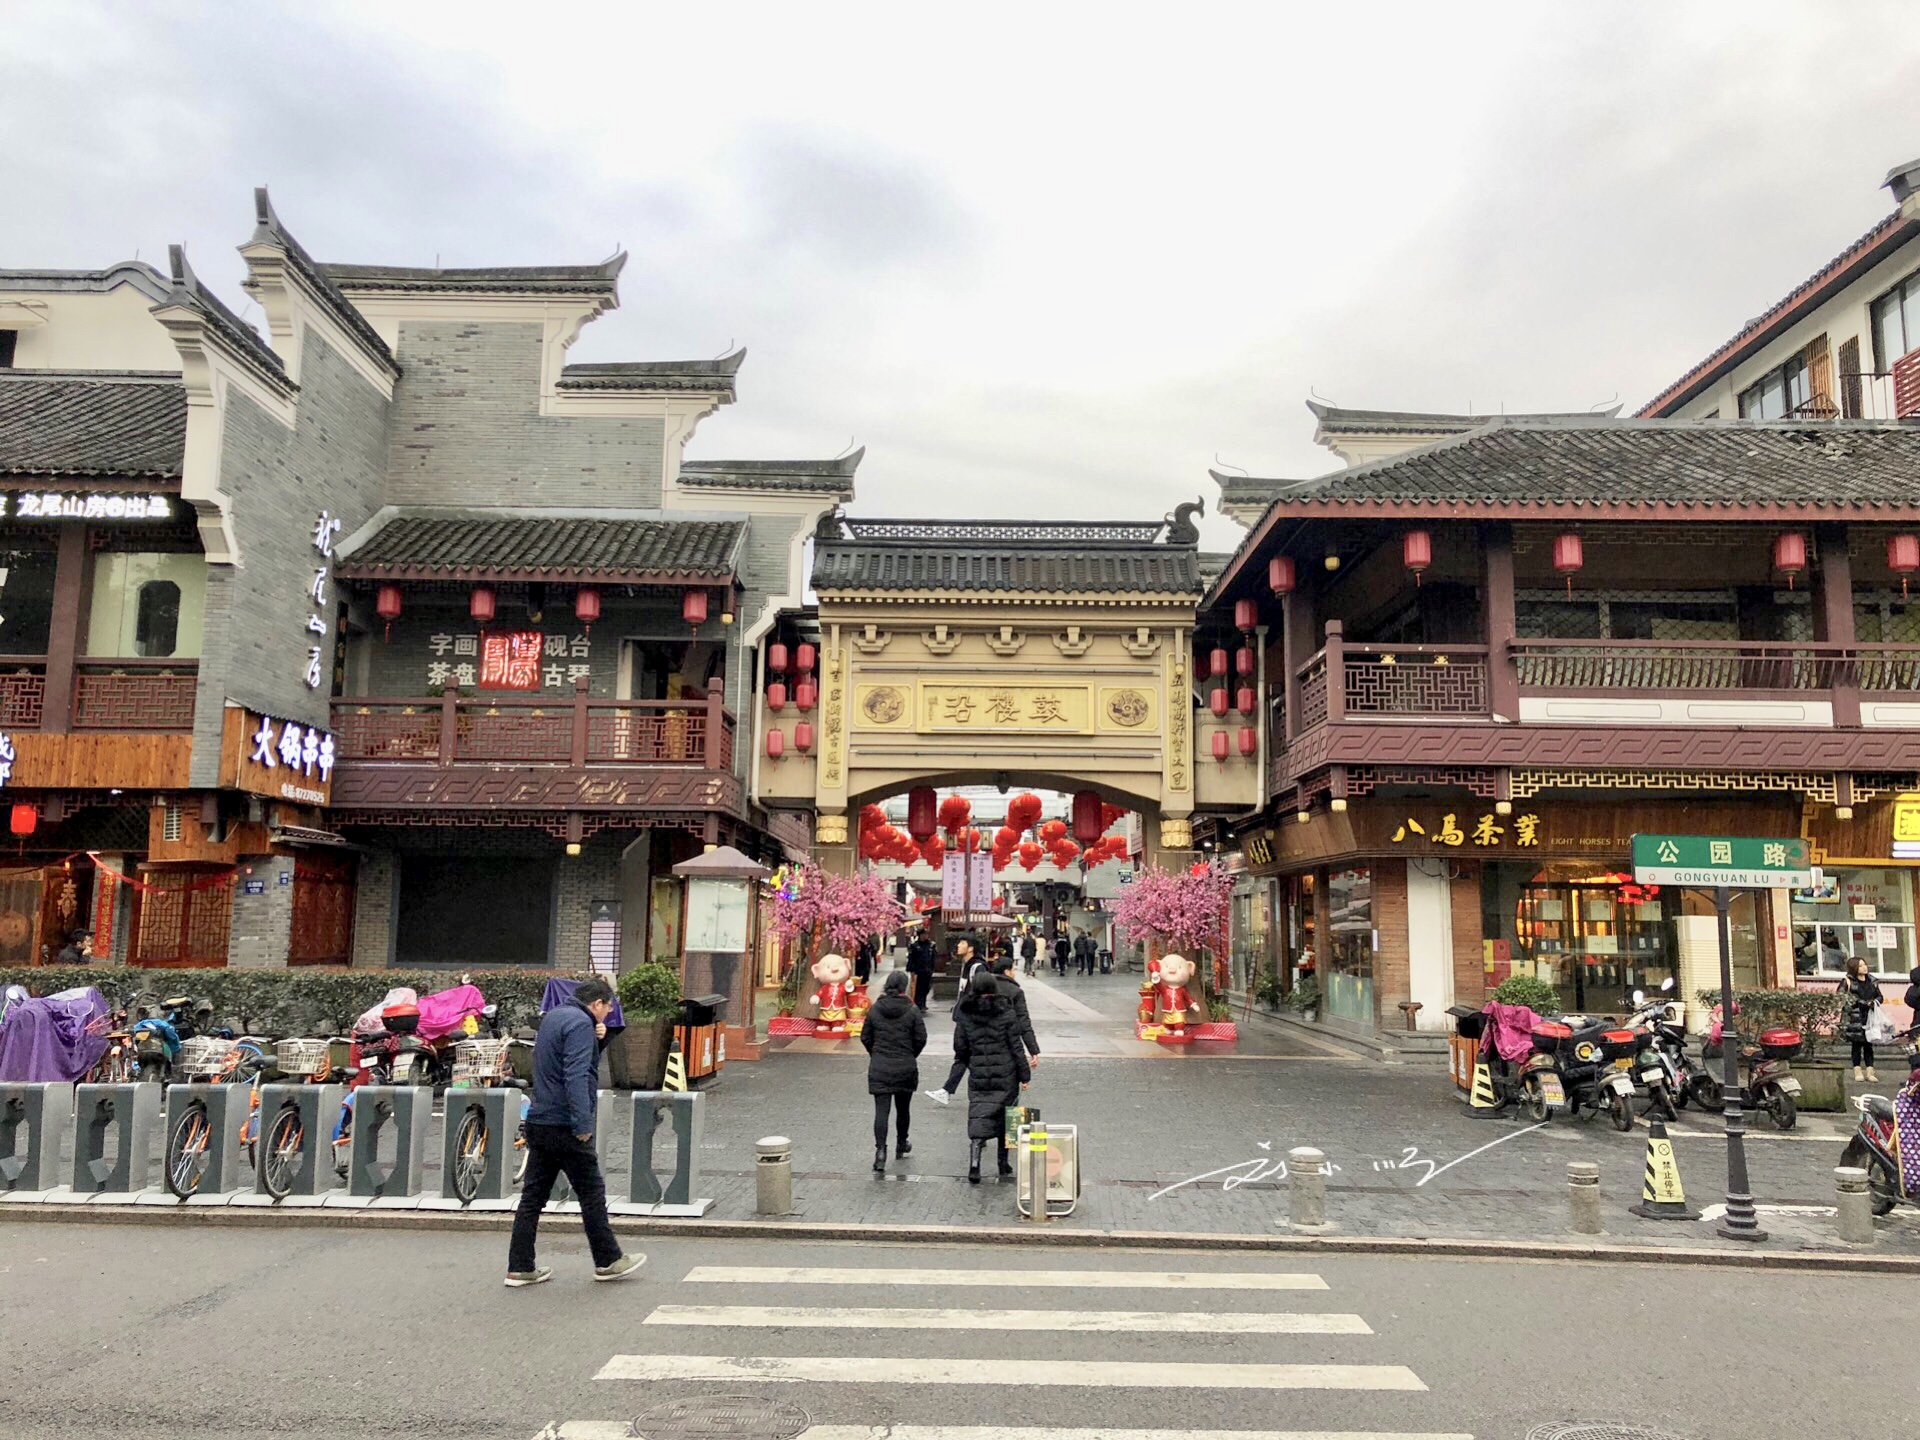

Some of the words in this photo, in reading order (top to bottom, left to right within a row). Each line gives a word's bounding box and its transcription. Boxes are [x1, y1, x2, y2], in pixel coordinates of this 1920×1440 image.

[429, 633, 477, 657] 字画
[544, 634, 591, 658] 砚台
[428, 661, 476, 686] 茶盘
[543, 663, 590, 687] 古琴
[1391, 813, 1541, 847] 八馬茶業
[1551, 837, 1573, 845] EIGHT
[1579, 837, 1611, 846] HORSES
[1616, 838, 1632, 846] TEA
[1656, 840, 1787, 867] 公园路
[1674, 872, 1748, 884] GONGYUAN
[1754, 875, 1769, 884] LU
[1791, 876, 1800, 885] 南
[1662, 1161, 1675, 1198] 禁止停车
